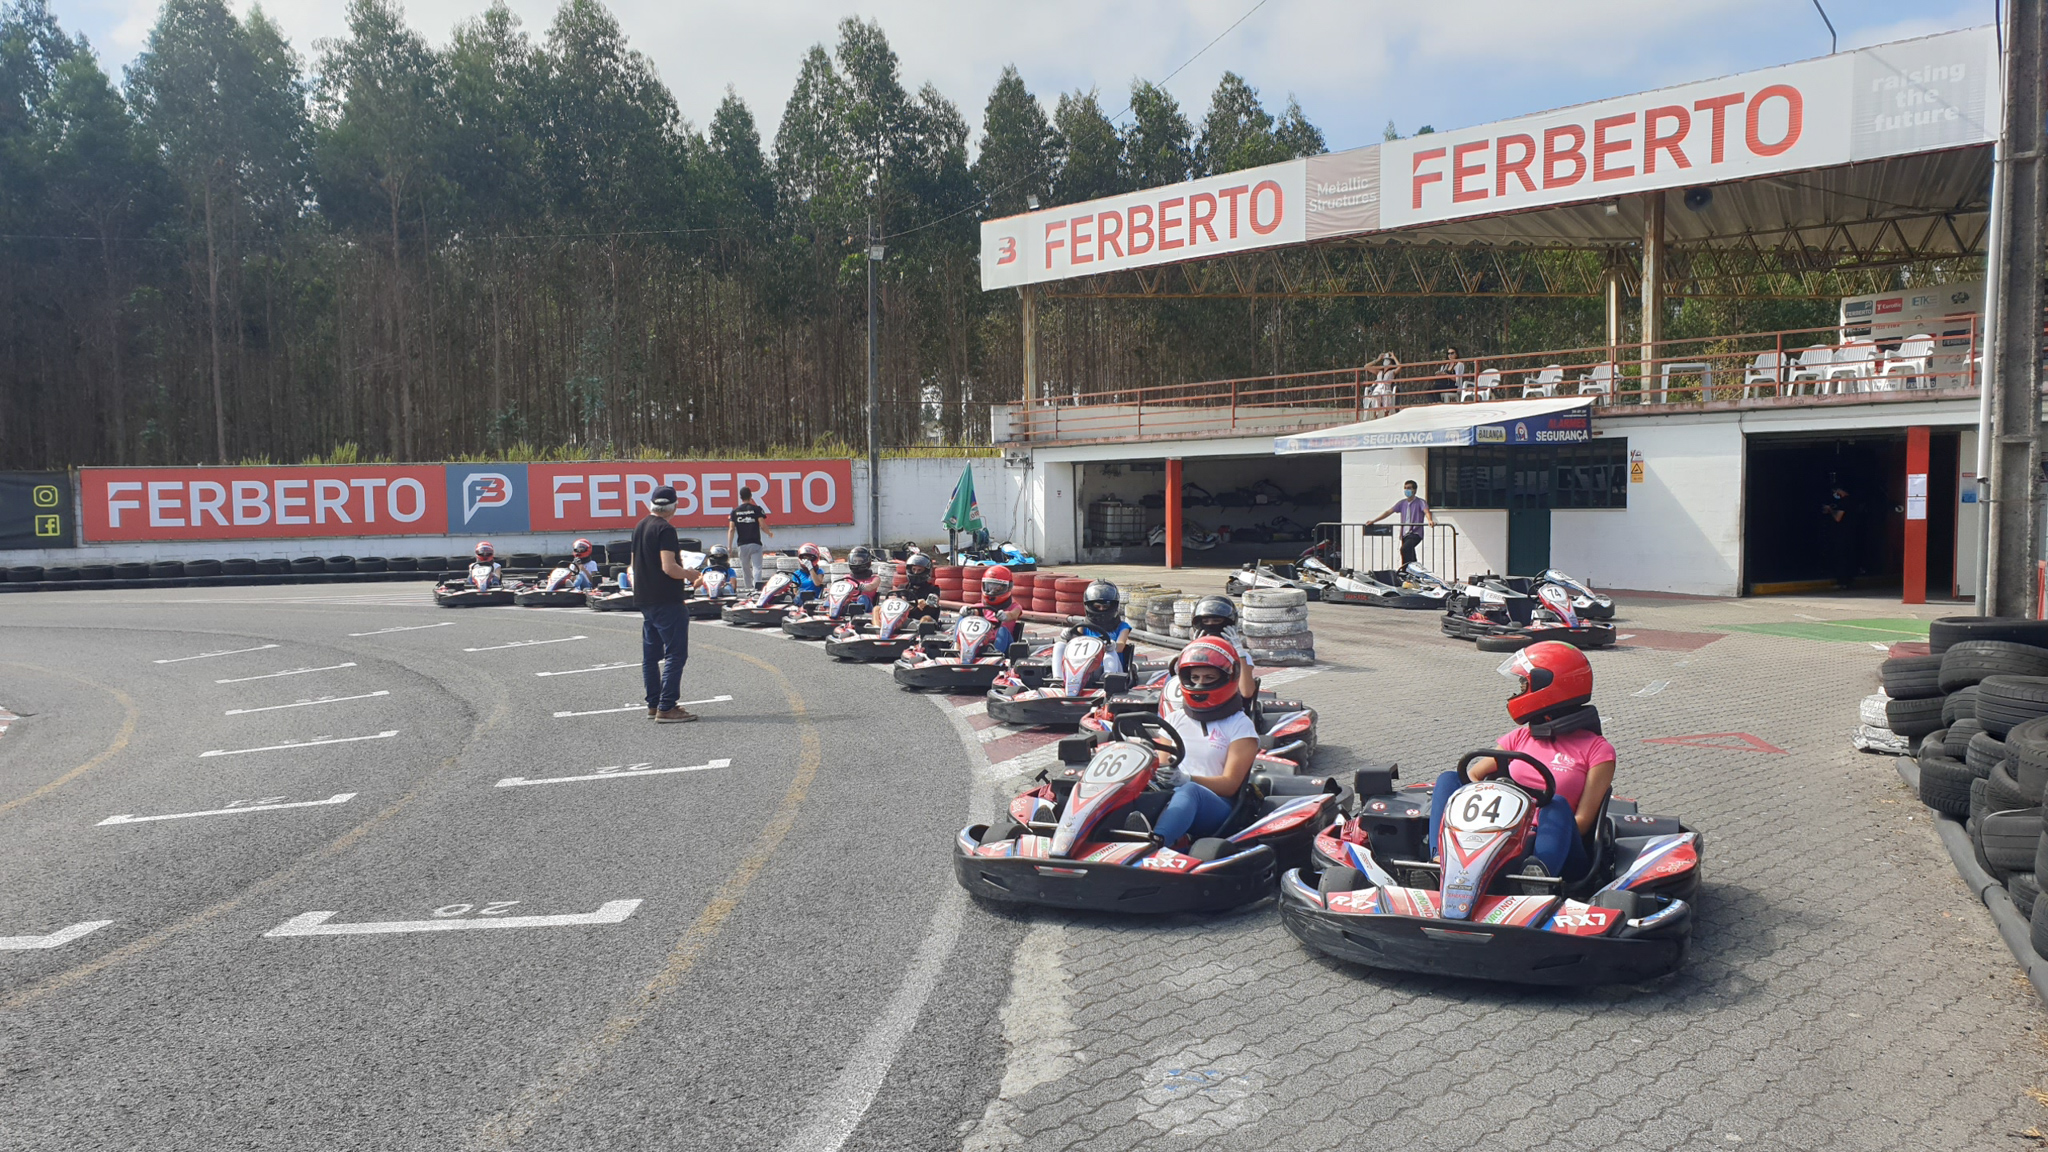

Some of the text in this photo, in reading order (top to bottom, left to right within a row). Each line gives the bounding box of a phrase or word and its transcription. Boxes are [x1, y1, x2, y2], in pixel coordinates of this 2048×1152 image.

[1872, 63, 1966, 93] raising
[1895, 88, 1939, 109] the
[1874, 106, 1960, 132] future
[1411, 84, 1804, 211] FERBERTO
[1316, 177, 1369, 197] Metallic
[1308, 192, 1378, 212] Structures
[1045, 180, 1283, 270] FERBERTO
[1548, 418, 1587, 430] ALARMES
[1362, 431, 1434, 446] SEGURANÇA
[1478, 428, 1504, 441] BALANÇA
[1535, 429, 1589, 443] SEGURANÇA
[107, 477, 427, 528] FERBERTO
[553, 471, 837, 519] FERBERTO
[708, 573, 719, 581] 61
[835, 583, 846, 595] 73
[1547, 587, 1562, 599] 74
[887, 600, 902, 612] 63
[967, 620, 980, 633] 75
[1072, 640, 1091, 657] 71
[1092, 752, 1128, 778] 66
[1463, 793, 1503, 824] 64
[1142, 857, 1188, 869] RX7
[1329, 894, 1378, 911] RX7
[1413, 890, 1434, 918] EUROIND
[1556, 912, 1607, 928] RX7
